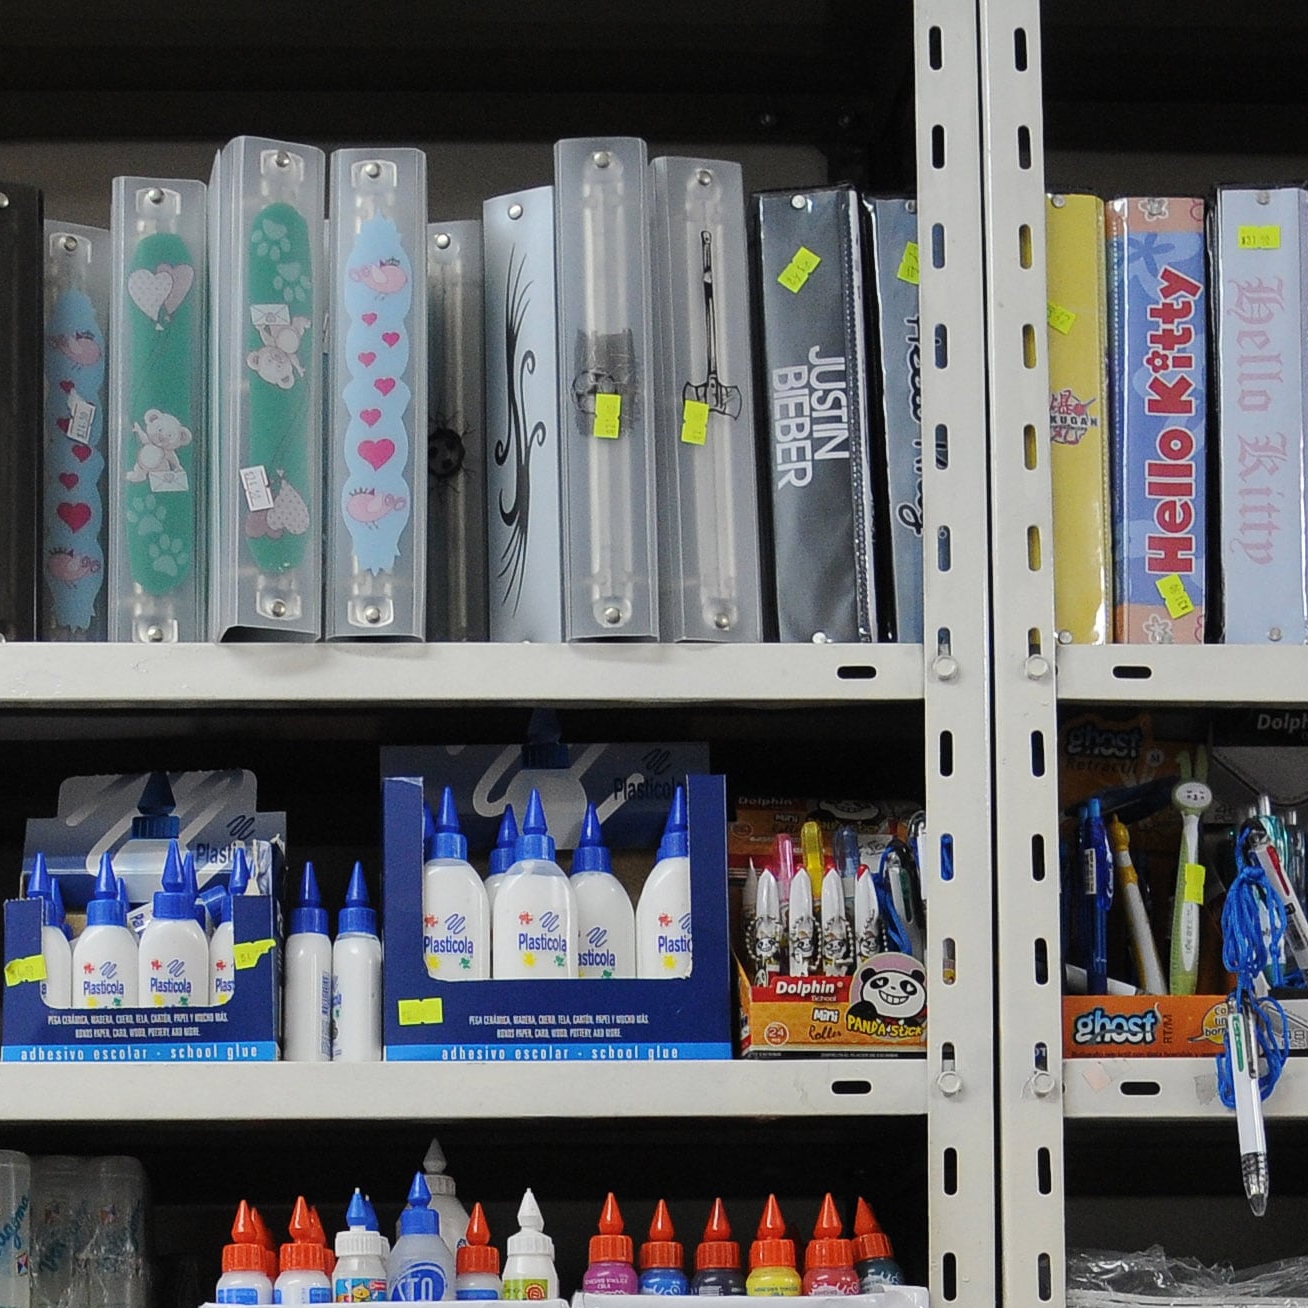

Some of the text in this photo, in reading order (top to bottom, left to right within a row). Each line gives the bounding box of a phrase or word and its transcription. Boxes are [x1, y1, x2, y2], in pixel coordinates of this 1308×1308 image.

[809, 345, 849, 460] JUSTIN
[772, 365, 812, 490] BIEBER
[1144, 266, 1203, 574] Hello Kitty
[1228, 276, 1288, 565] Hello Kitty
[424, 935, 474, 955] Plasticola
[518, 933, 568, 952] Plasticola
[83, 979, 125, 996] Plasticola
[150, 977, 191, 994] Plasticola
[775, 979, 836, 997] Dolphin
[812, 1008, 840, 1024] Mini
[847, 1014, 887, 1035] PANDA
[767, 1025, 785, 1038] 24
[1073, 1008, 1156, 1045] ghost
[442, 1046, 678, 1062] adhesivo escolar school glue
